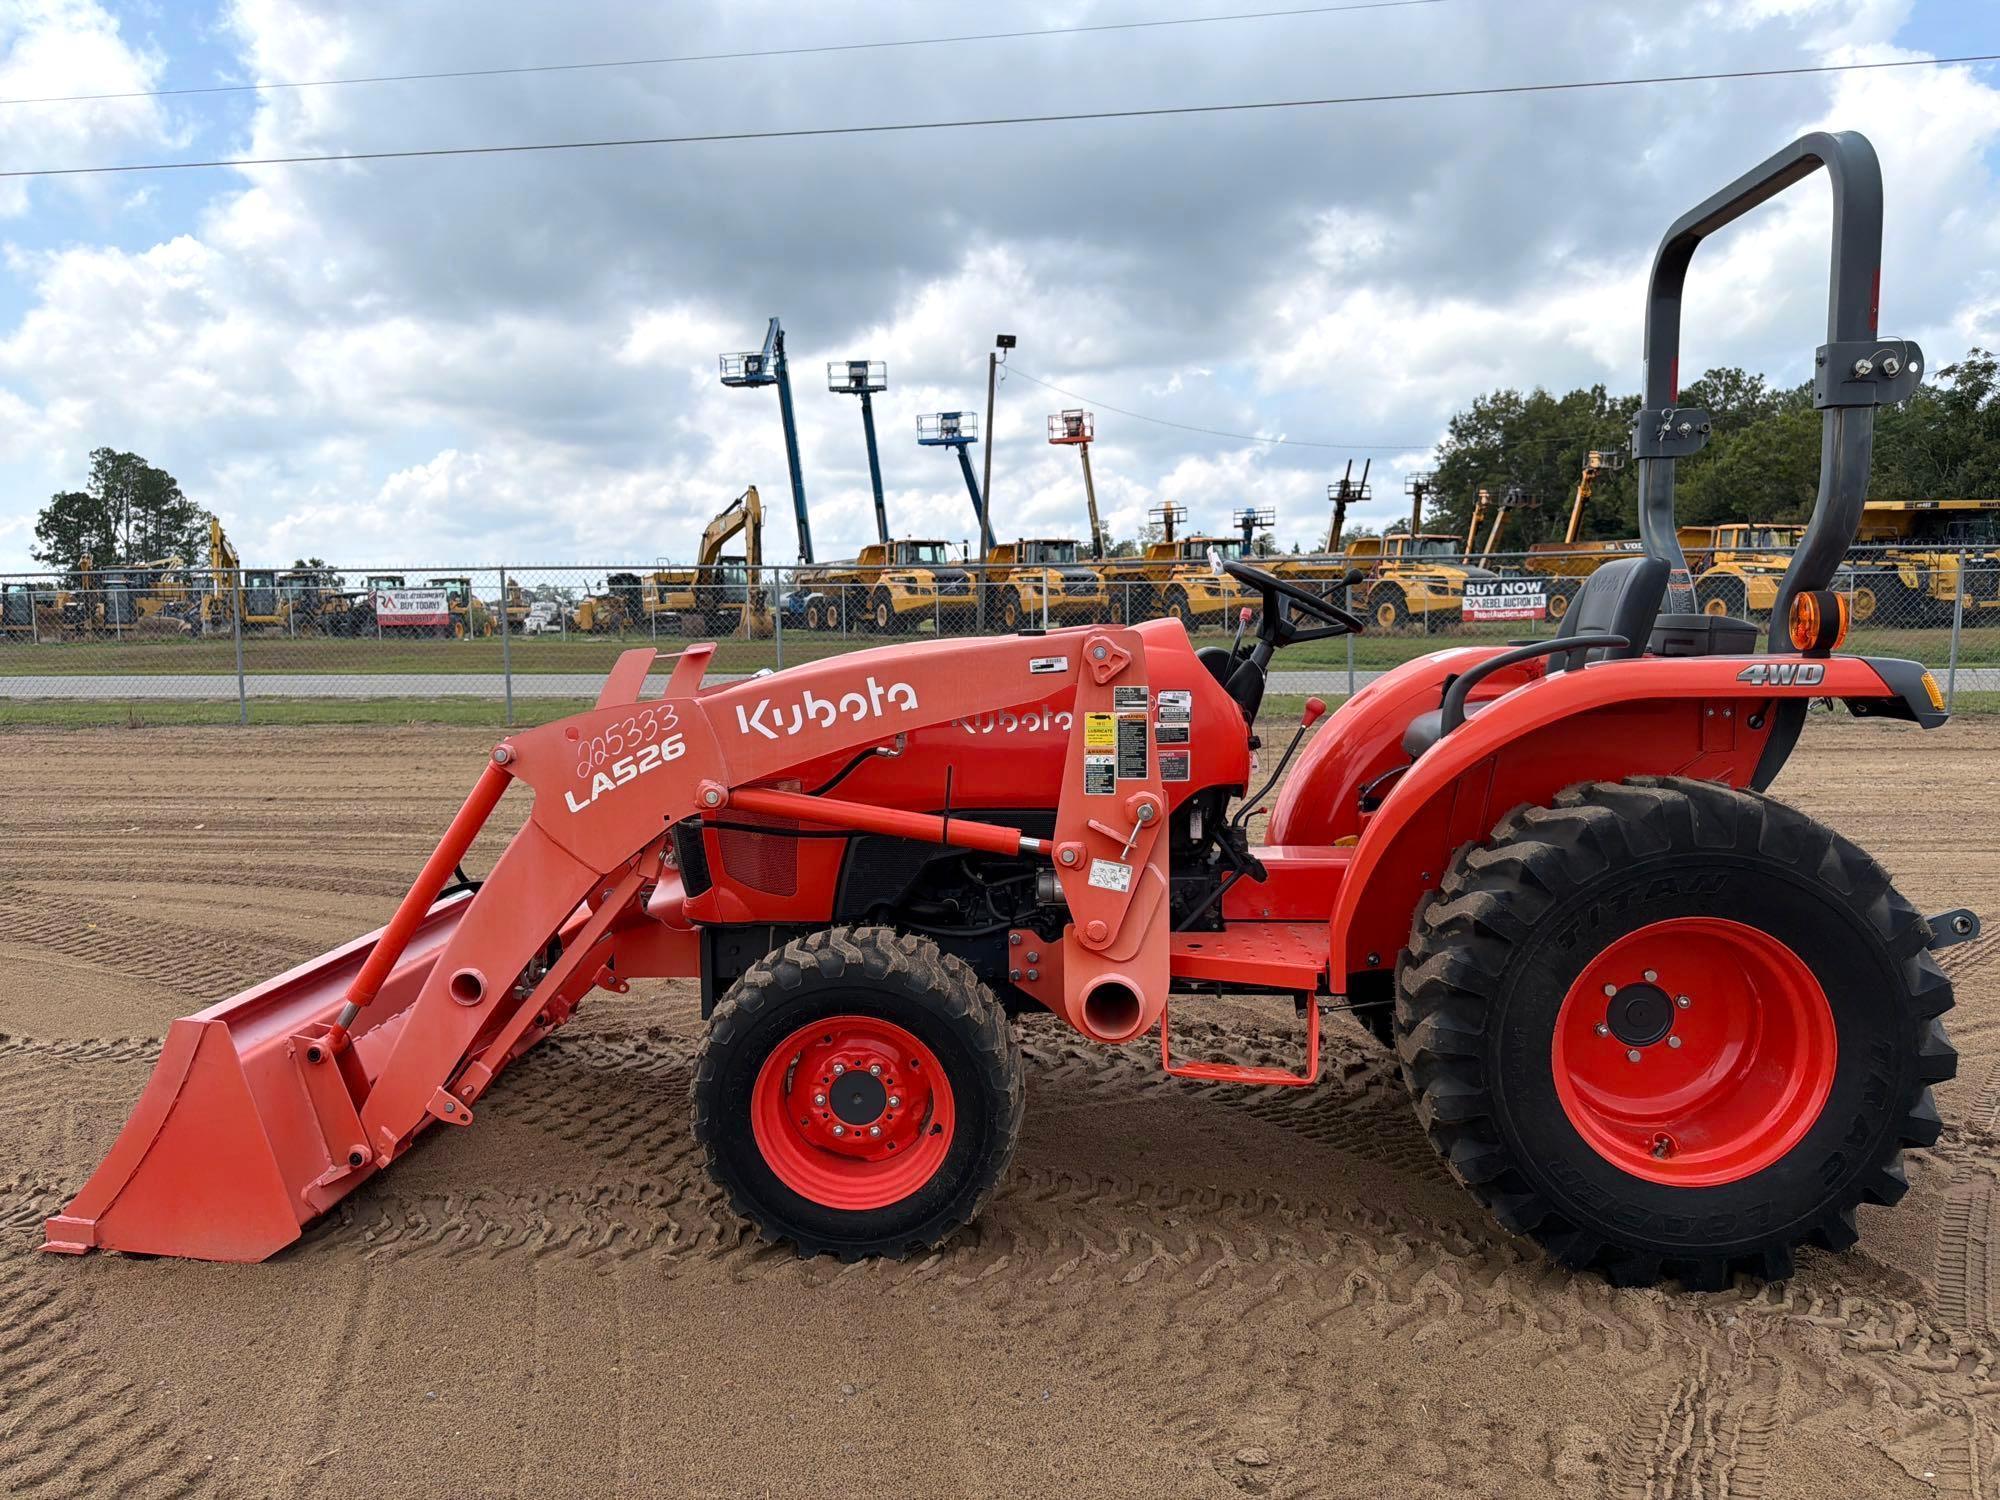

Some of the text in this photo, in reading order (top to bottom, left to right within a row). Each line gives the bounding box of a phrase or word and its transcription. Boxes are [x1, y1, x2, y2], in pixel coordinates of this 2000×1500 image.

[1623, 542, 1643, 550] VOL
[1466, 581, 1542, 596] BUY NOW
[400, 601, 414, 609] BUY
[1482, 598, 1501, 608] REBEL
[1504, 597, 1531, 607] AUCTION
[1736, 664, 1825, 686] 4WD
[735, 676, 919, 739] Kubota
[577, 704, 679, 778] 225333
[564, 732, 686, 813] LA526
